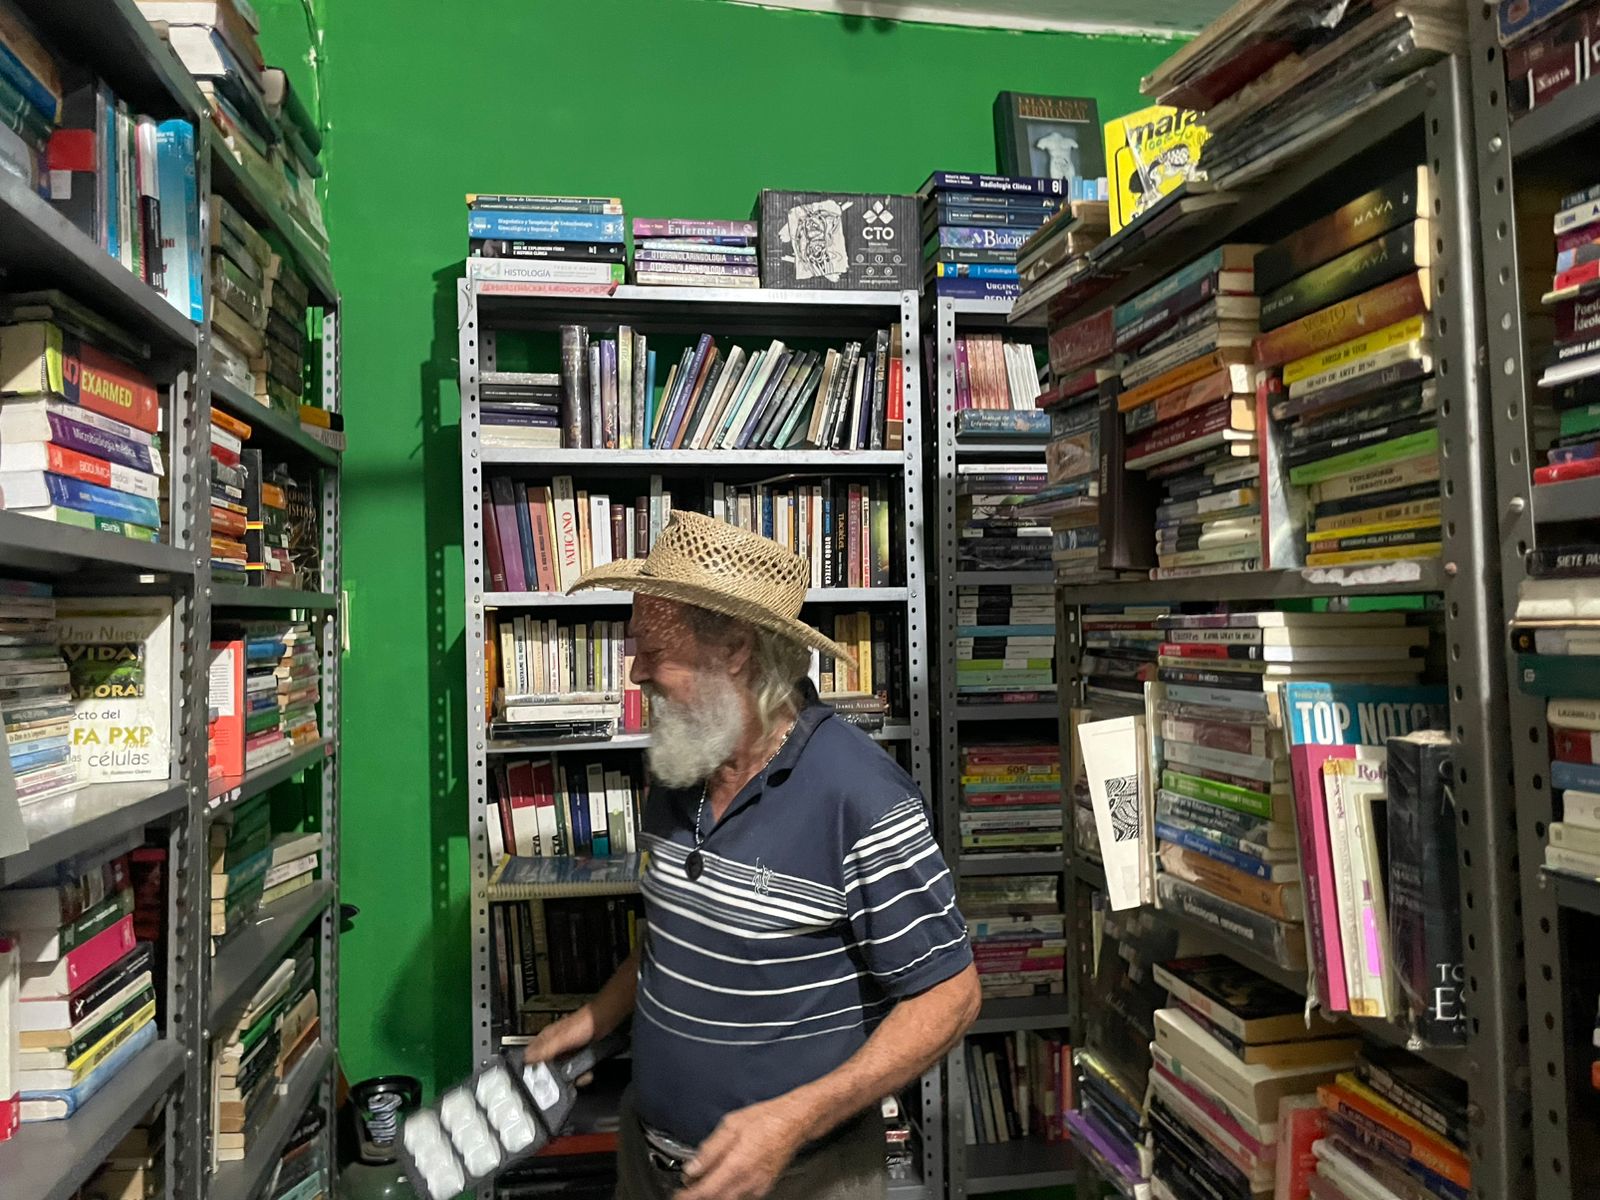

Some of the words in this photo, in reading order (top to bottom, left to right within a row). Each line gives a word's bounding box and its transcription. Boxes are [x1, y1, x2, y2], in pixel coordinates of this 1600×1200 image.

[862, 227, 895, 240] CTO
[503, 268, 551, 278] HISTOLOGÍA
[81, 370, 133, 408] EXARMED
[562, 511, 576, 567] VATICANO
[824, 536, 832, 559] OTOÑO
[1556, 553, 1584, 568] SIETE
[824, 561, 832, 585] AZTECA
[101, 709, 121, 720] del
[1295, 701, 1351, 745] TOP
[69, 728, 101, 745] FA
[87, 750, 150, 767] células
[1006, 765, 1025, 775] SOS
